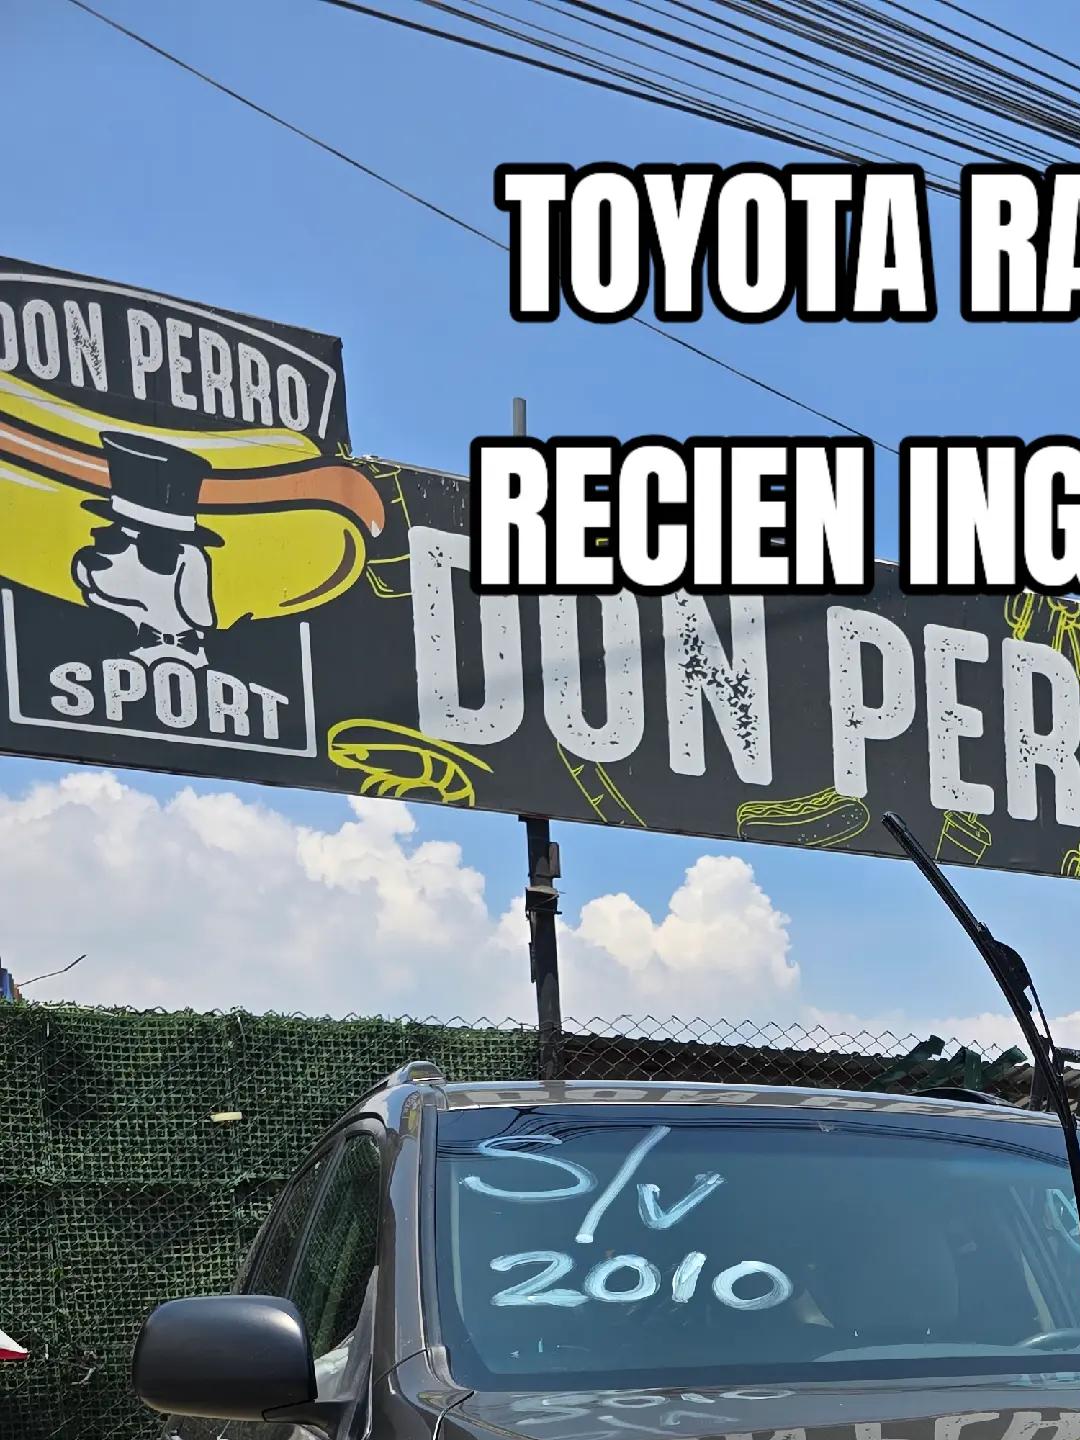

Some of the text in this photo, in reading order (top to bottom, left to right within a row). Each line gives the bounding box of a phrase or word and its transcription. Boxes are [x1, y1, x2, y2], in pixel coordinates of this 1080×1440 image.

[126, 308, 311, 432] PERRO
[49, 657, 290, 740] SPORT
[408, 525, 773, 786] DON
[489, 1250, 794, 1311] 2010
